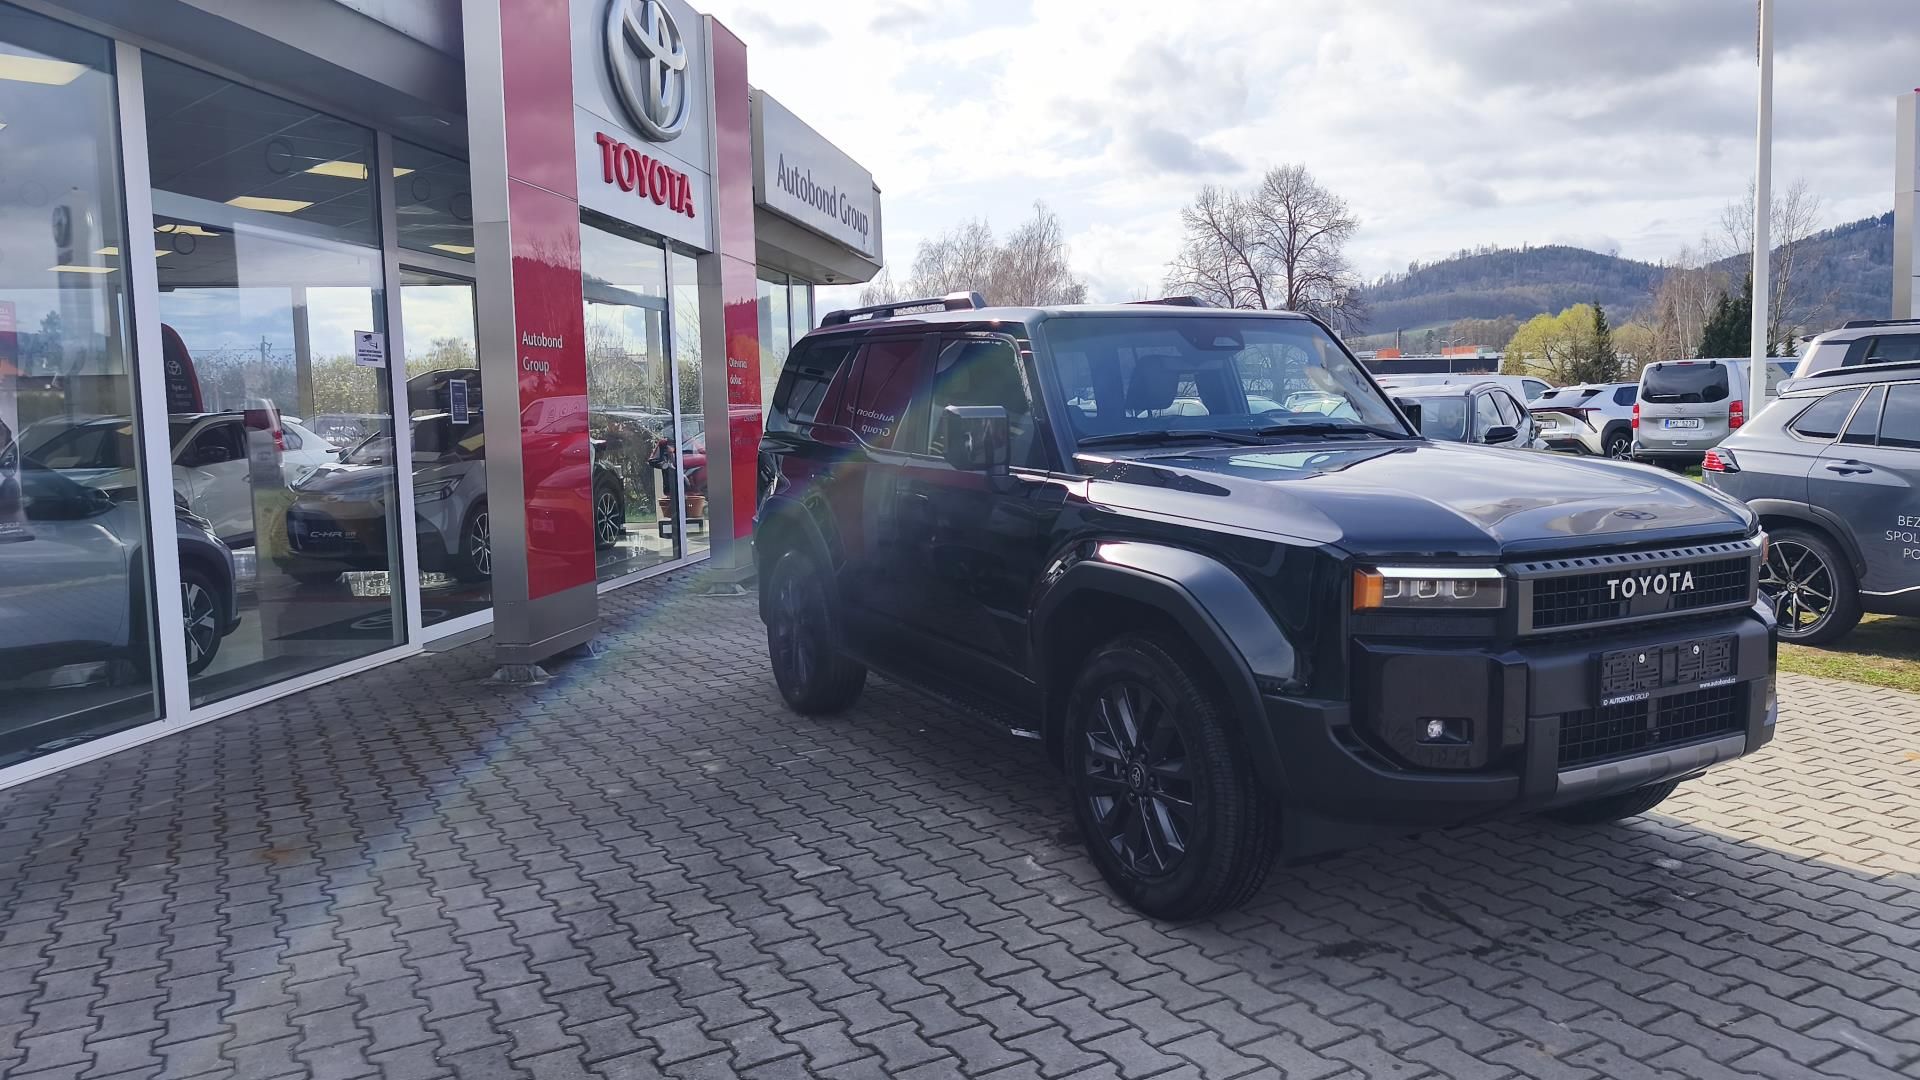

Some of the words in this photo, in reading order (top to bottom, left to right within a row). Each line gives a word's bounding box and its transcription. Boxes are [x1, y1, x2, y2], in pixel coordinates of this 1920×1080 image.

[596, 132, 695, 218] TOYOTA
[777, 153, 837, 219] Autobond
[839, 192, 868, 244] Group
[522, 331, 563, 349] Autobond
[523, 356, 550, 376] Group
[1607, 571, 1695, 600] TOYOTA
[1609, 695, 1635, 705] AUTOBOND
[1635, 692, 1650, 701] GROUP
